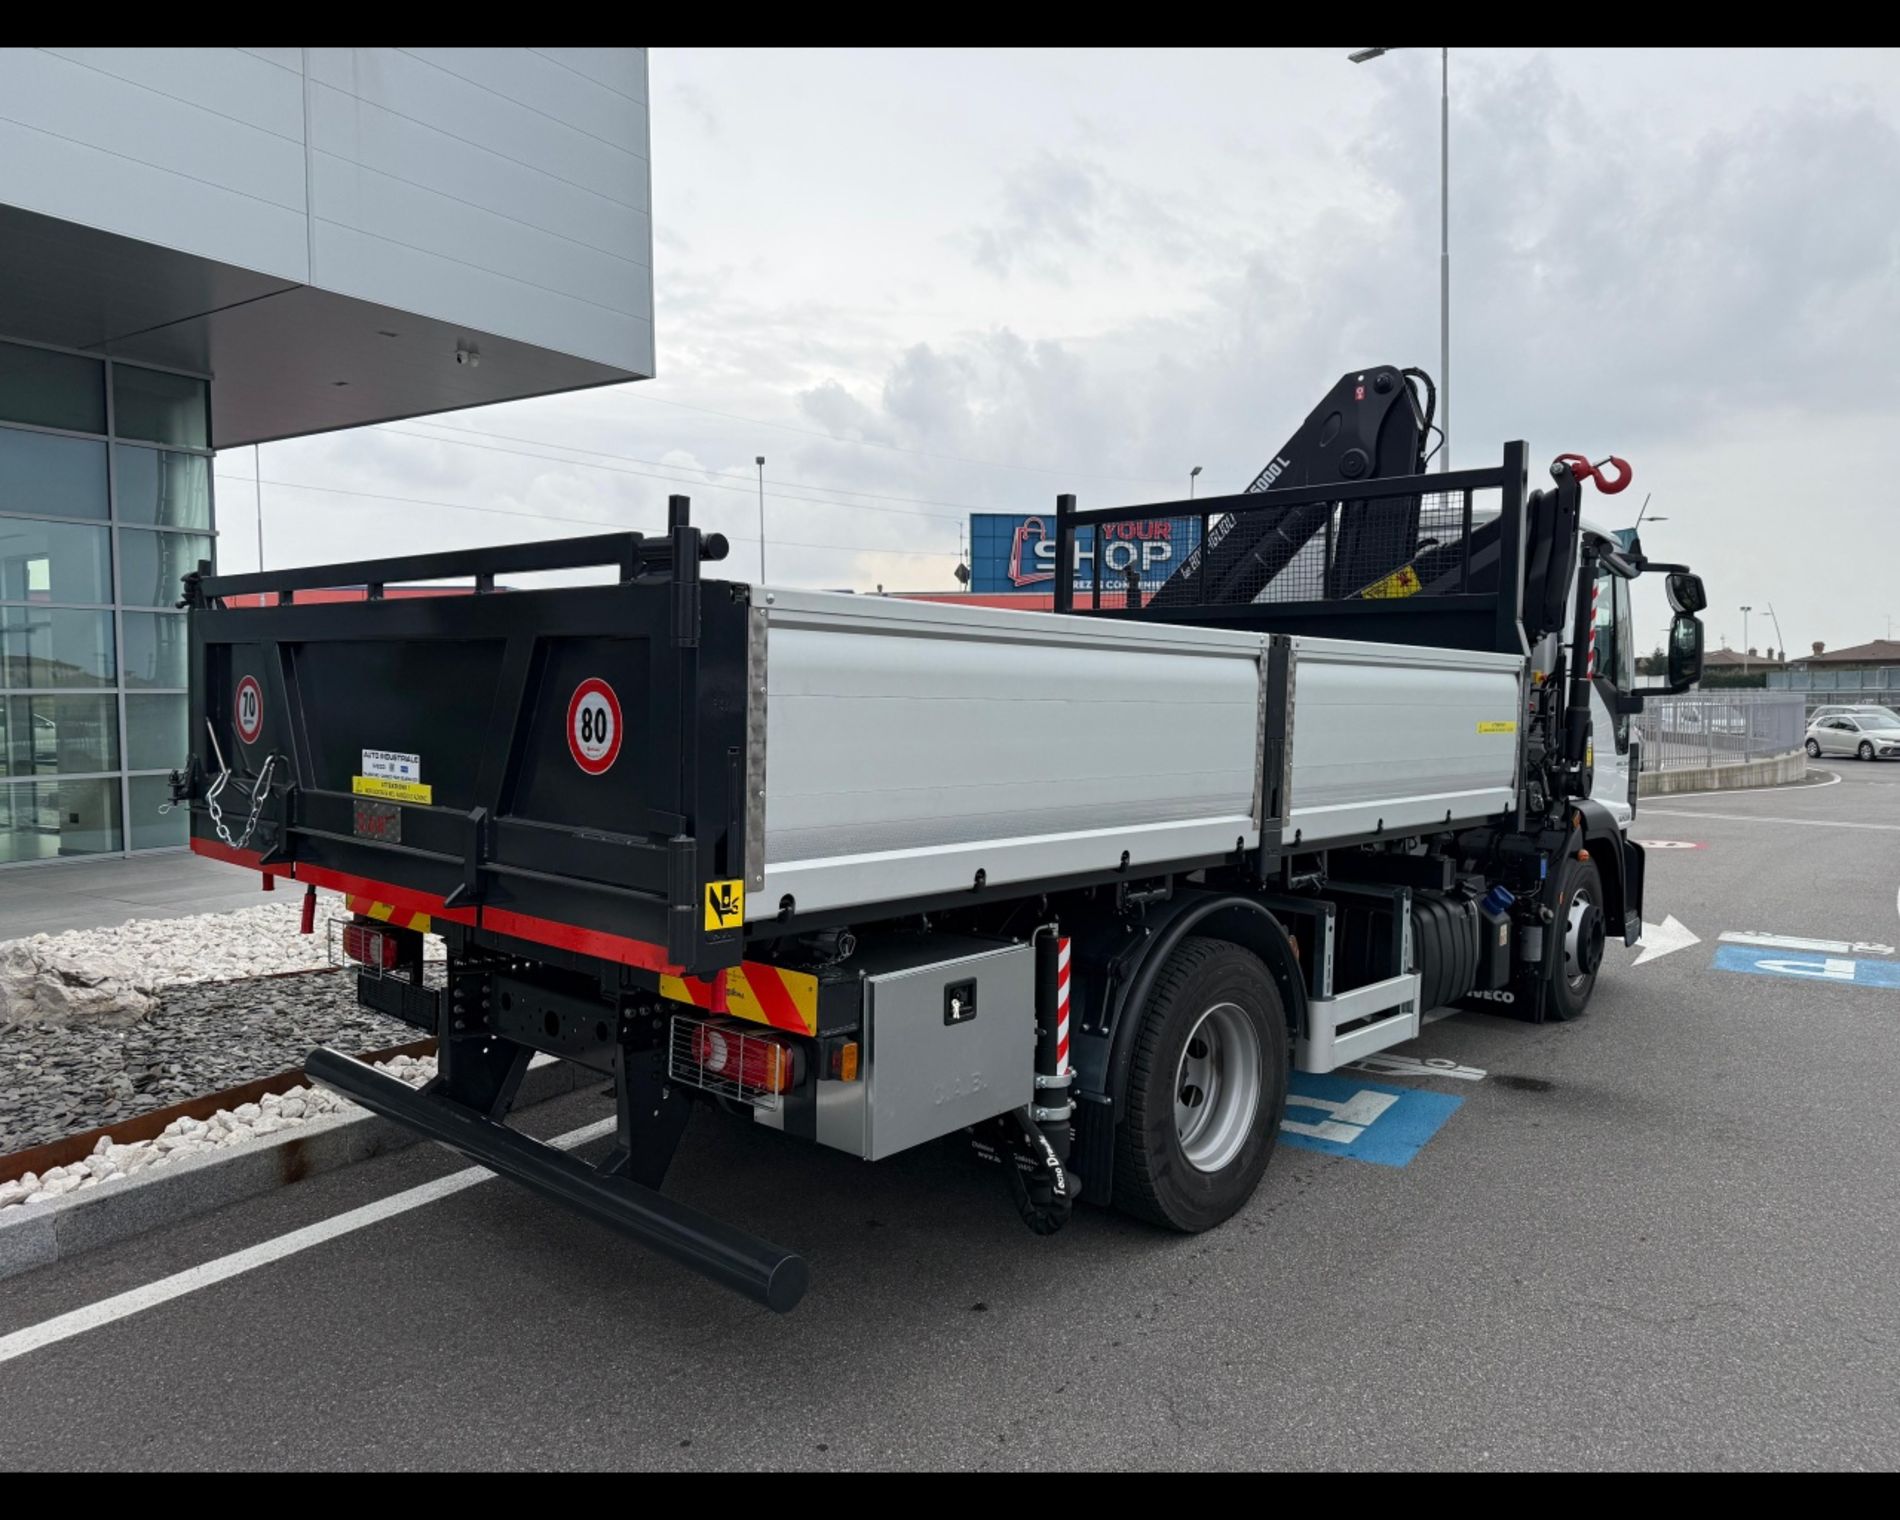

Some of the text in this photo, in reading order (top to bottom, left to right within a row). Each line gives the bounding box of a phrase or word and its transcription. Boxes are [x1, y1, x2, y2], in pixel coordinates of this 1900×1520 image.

[1103, 520, 1172, 540] YOUR
[1034, 540, 1172, 571] SHOP
[243, 692, 255, 717] 70
[581, 707, 607, 744] 80
[1053, 1167, 1066, 1195] Tecno
